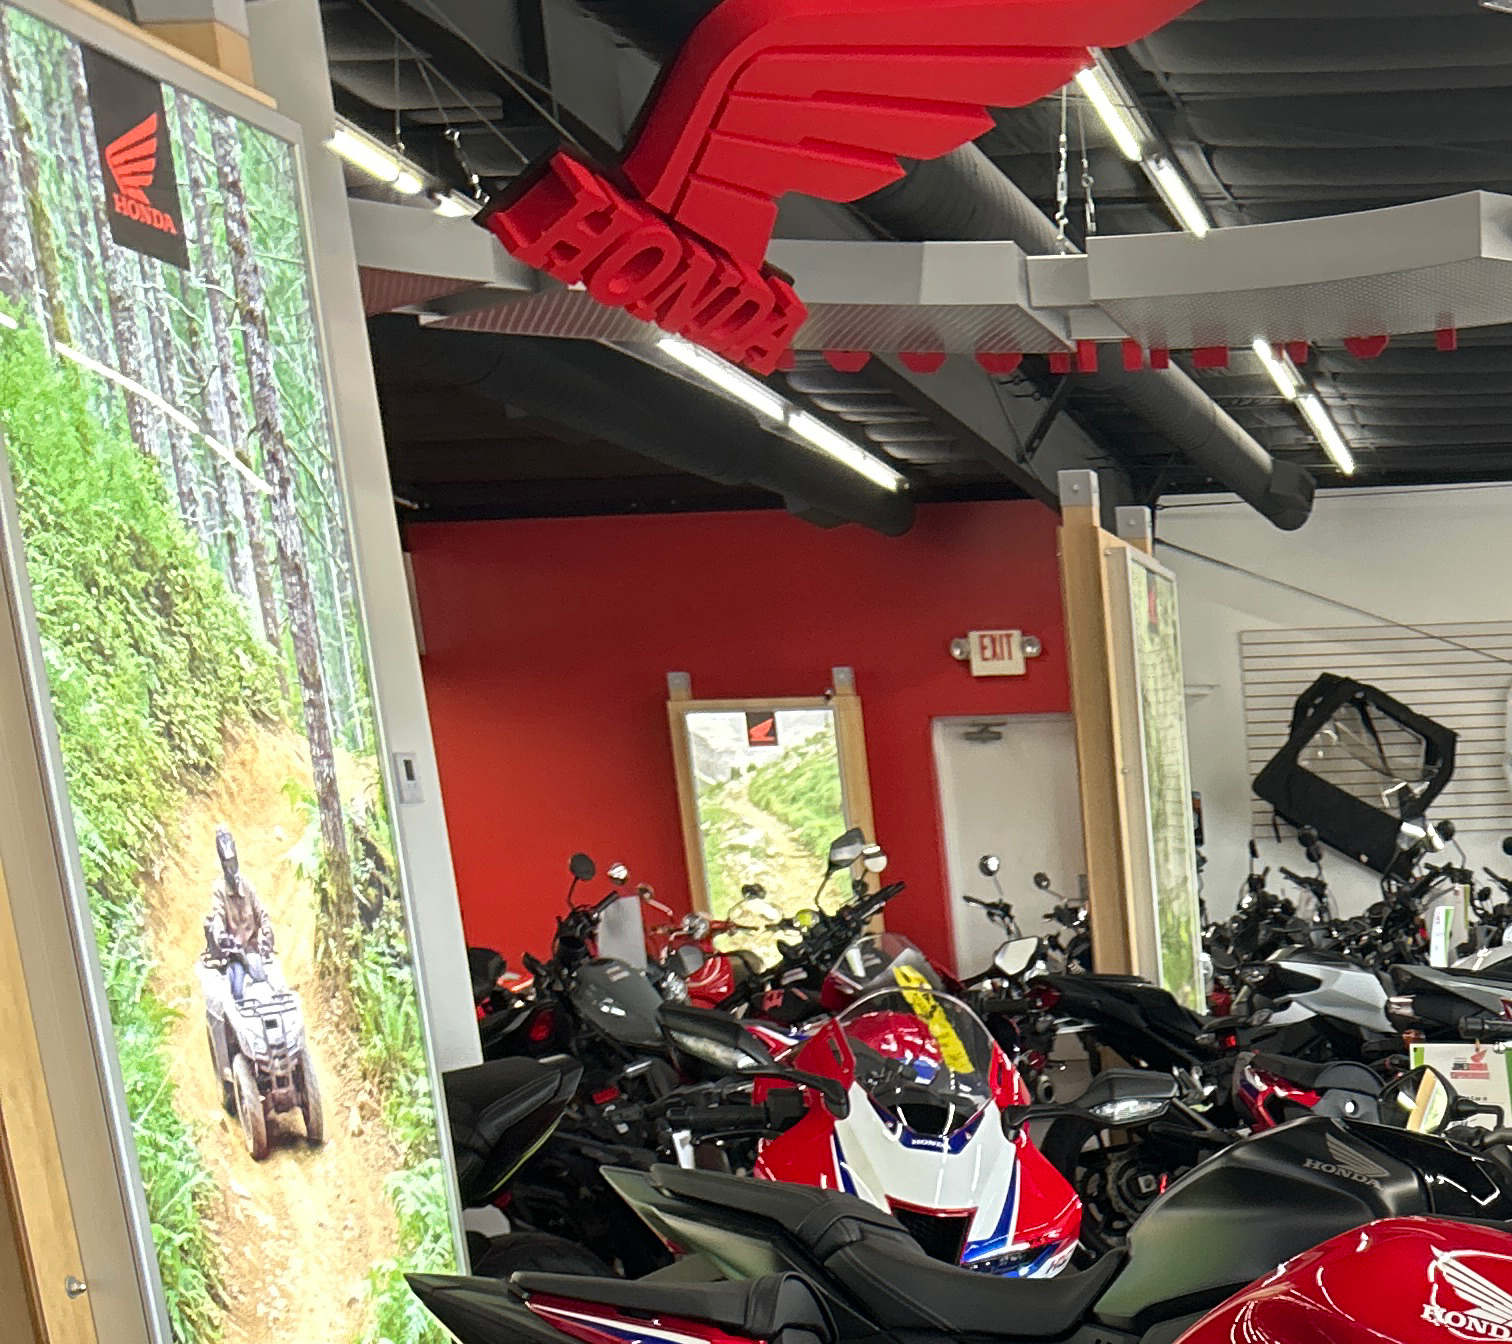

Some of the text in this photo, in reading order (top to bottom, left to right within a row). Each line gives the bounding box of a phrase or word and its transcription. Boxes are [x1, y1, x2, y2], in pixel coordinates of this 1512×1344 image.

[113, 193, 178, 235] HONDA
[488, 150, 808, 378] HONDA
[979, 632, 1014, 661] EXIT
[1302, 1158, 1385, 1192] HONDA
